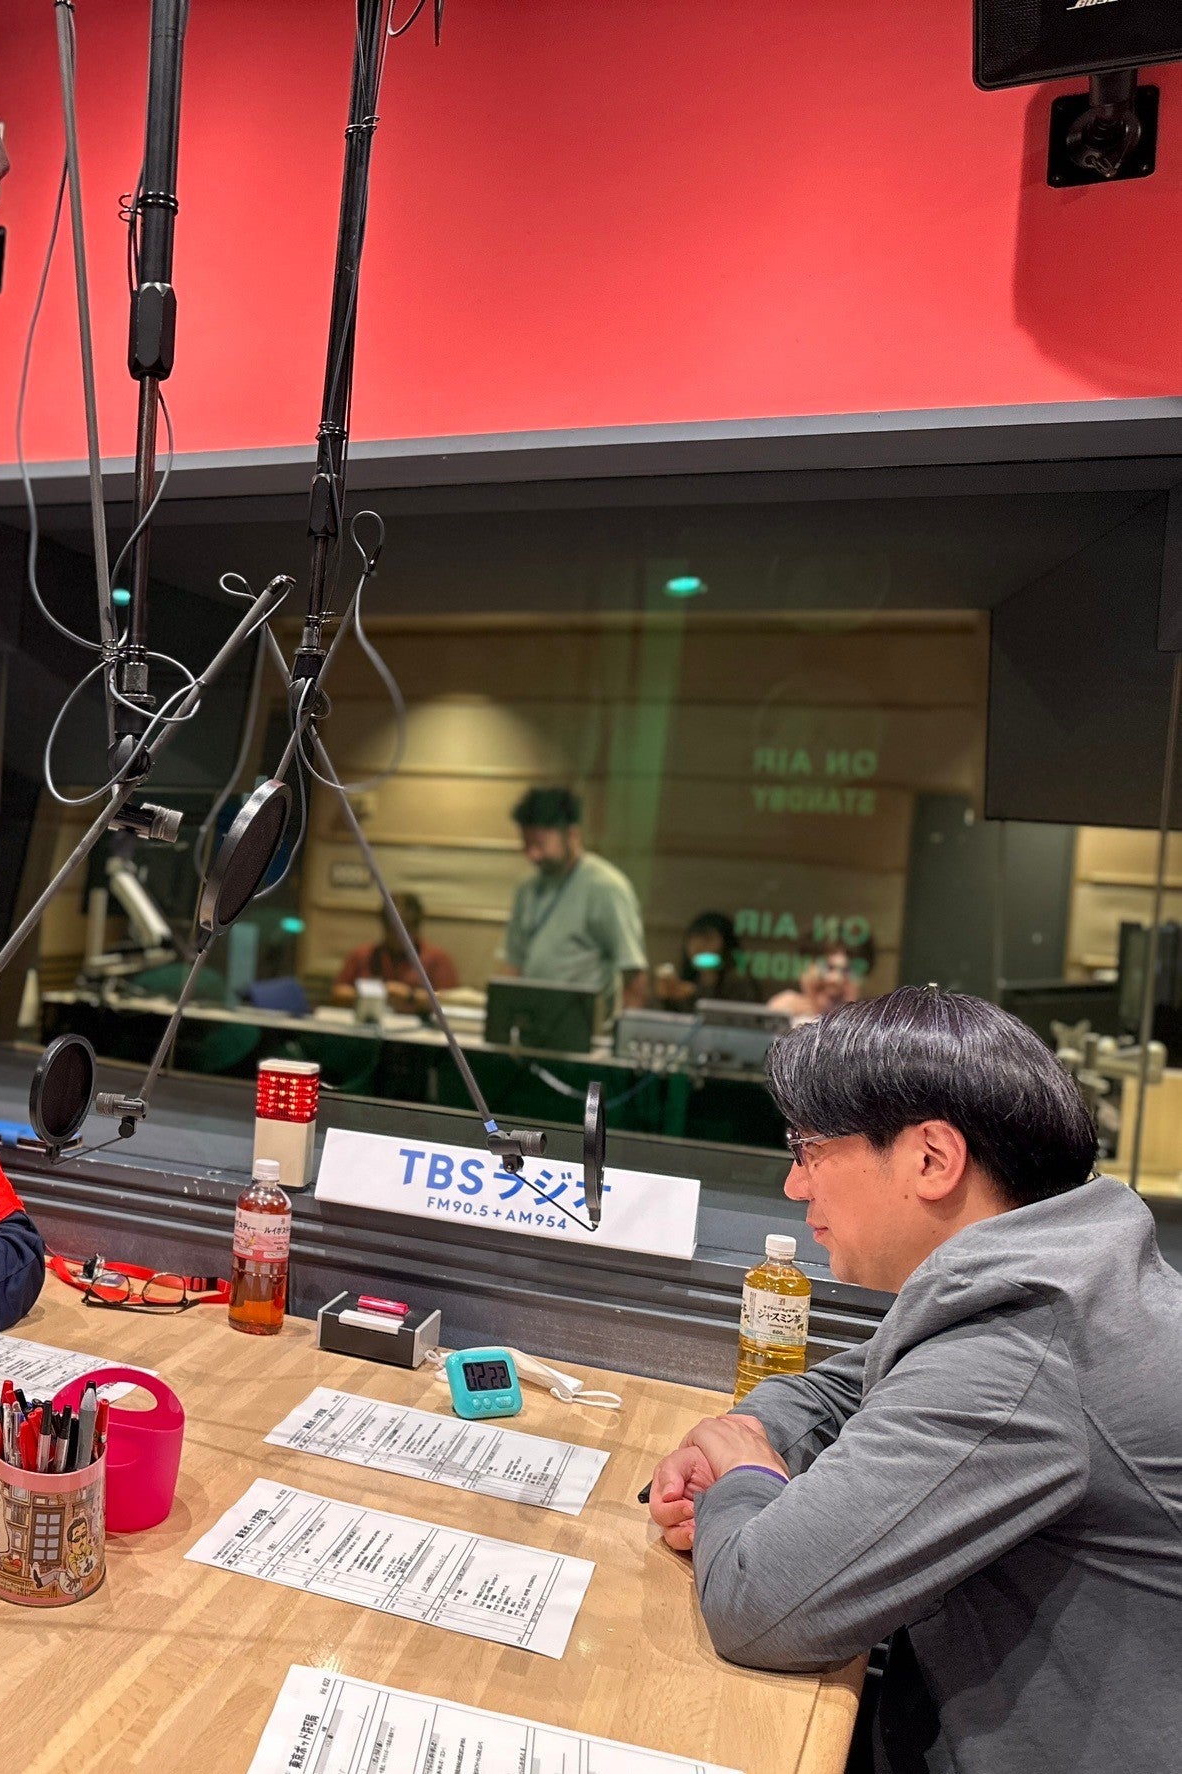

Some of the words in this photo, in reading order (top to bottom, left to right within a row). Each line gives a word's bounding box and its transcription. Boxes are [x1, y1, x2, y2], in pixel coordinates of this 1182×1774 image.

[288, 1714, 320, 1769] 東京ポッド許可局
